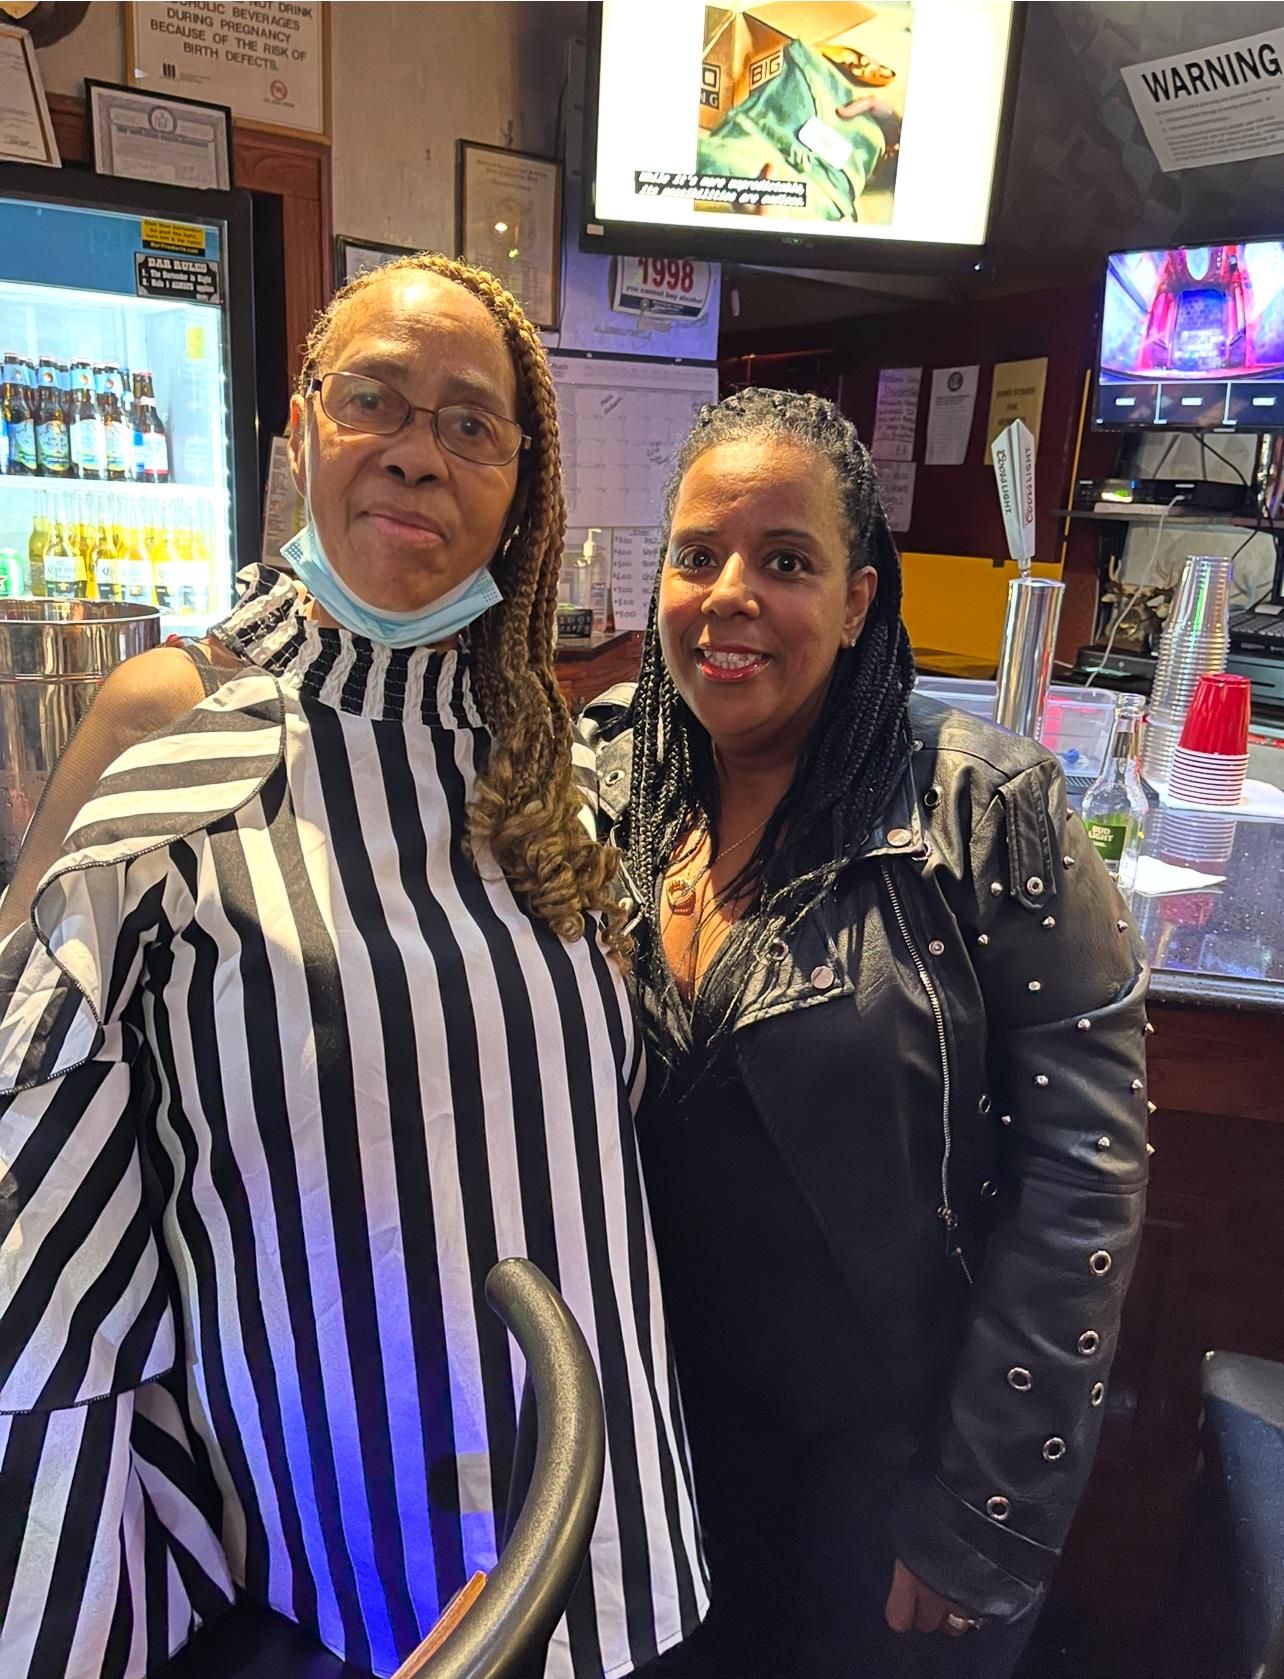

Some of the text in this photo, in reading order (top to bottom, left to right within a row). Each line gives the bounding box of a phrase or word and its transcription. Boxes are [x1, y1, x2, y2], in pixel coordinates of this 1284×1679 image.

[166, 7, 291, 43] DURING PREGNANCY
[232, 7, 300, 31] BEVERAGES
[278, 2, 313, 19] DRINK
[150, 19, 307, 61] BECAUSE OF THE RISK OF
[183, 42, 279, 71] BIRTH DEFECTS.
[751, 54, 780, 86] BIG
[1141, 43, 1283, 103] WARNING
[173, 260, 207, 273] RULES
[638, 256, 694, 293] 1998
[640, 288, 664, 298] cannot
[996, 448, 1012, 514] Coors LIGHT
[1025, 447, 1034, 525] Coors LIGHT
[1088, 830, 1114, 842] LIGHT
[1091, 825, 1111, 835] BUD
